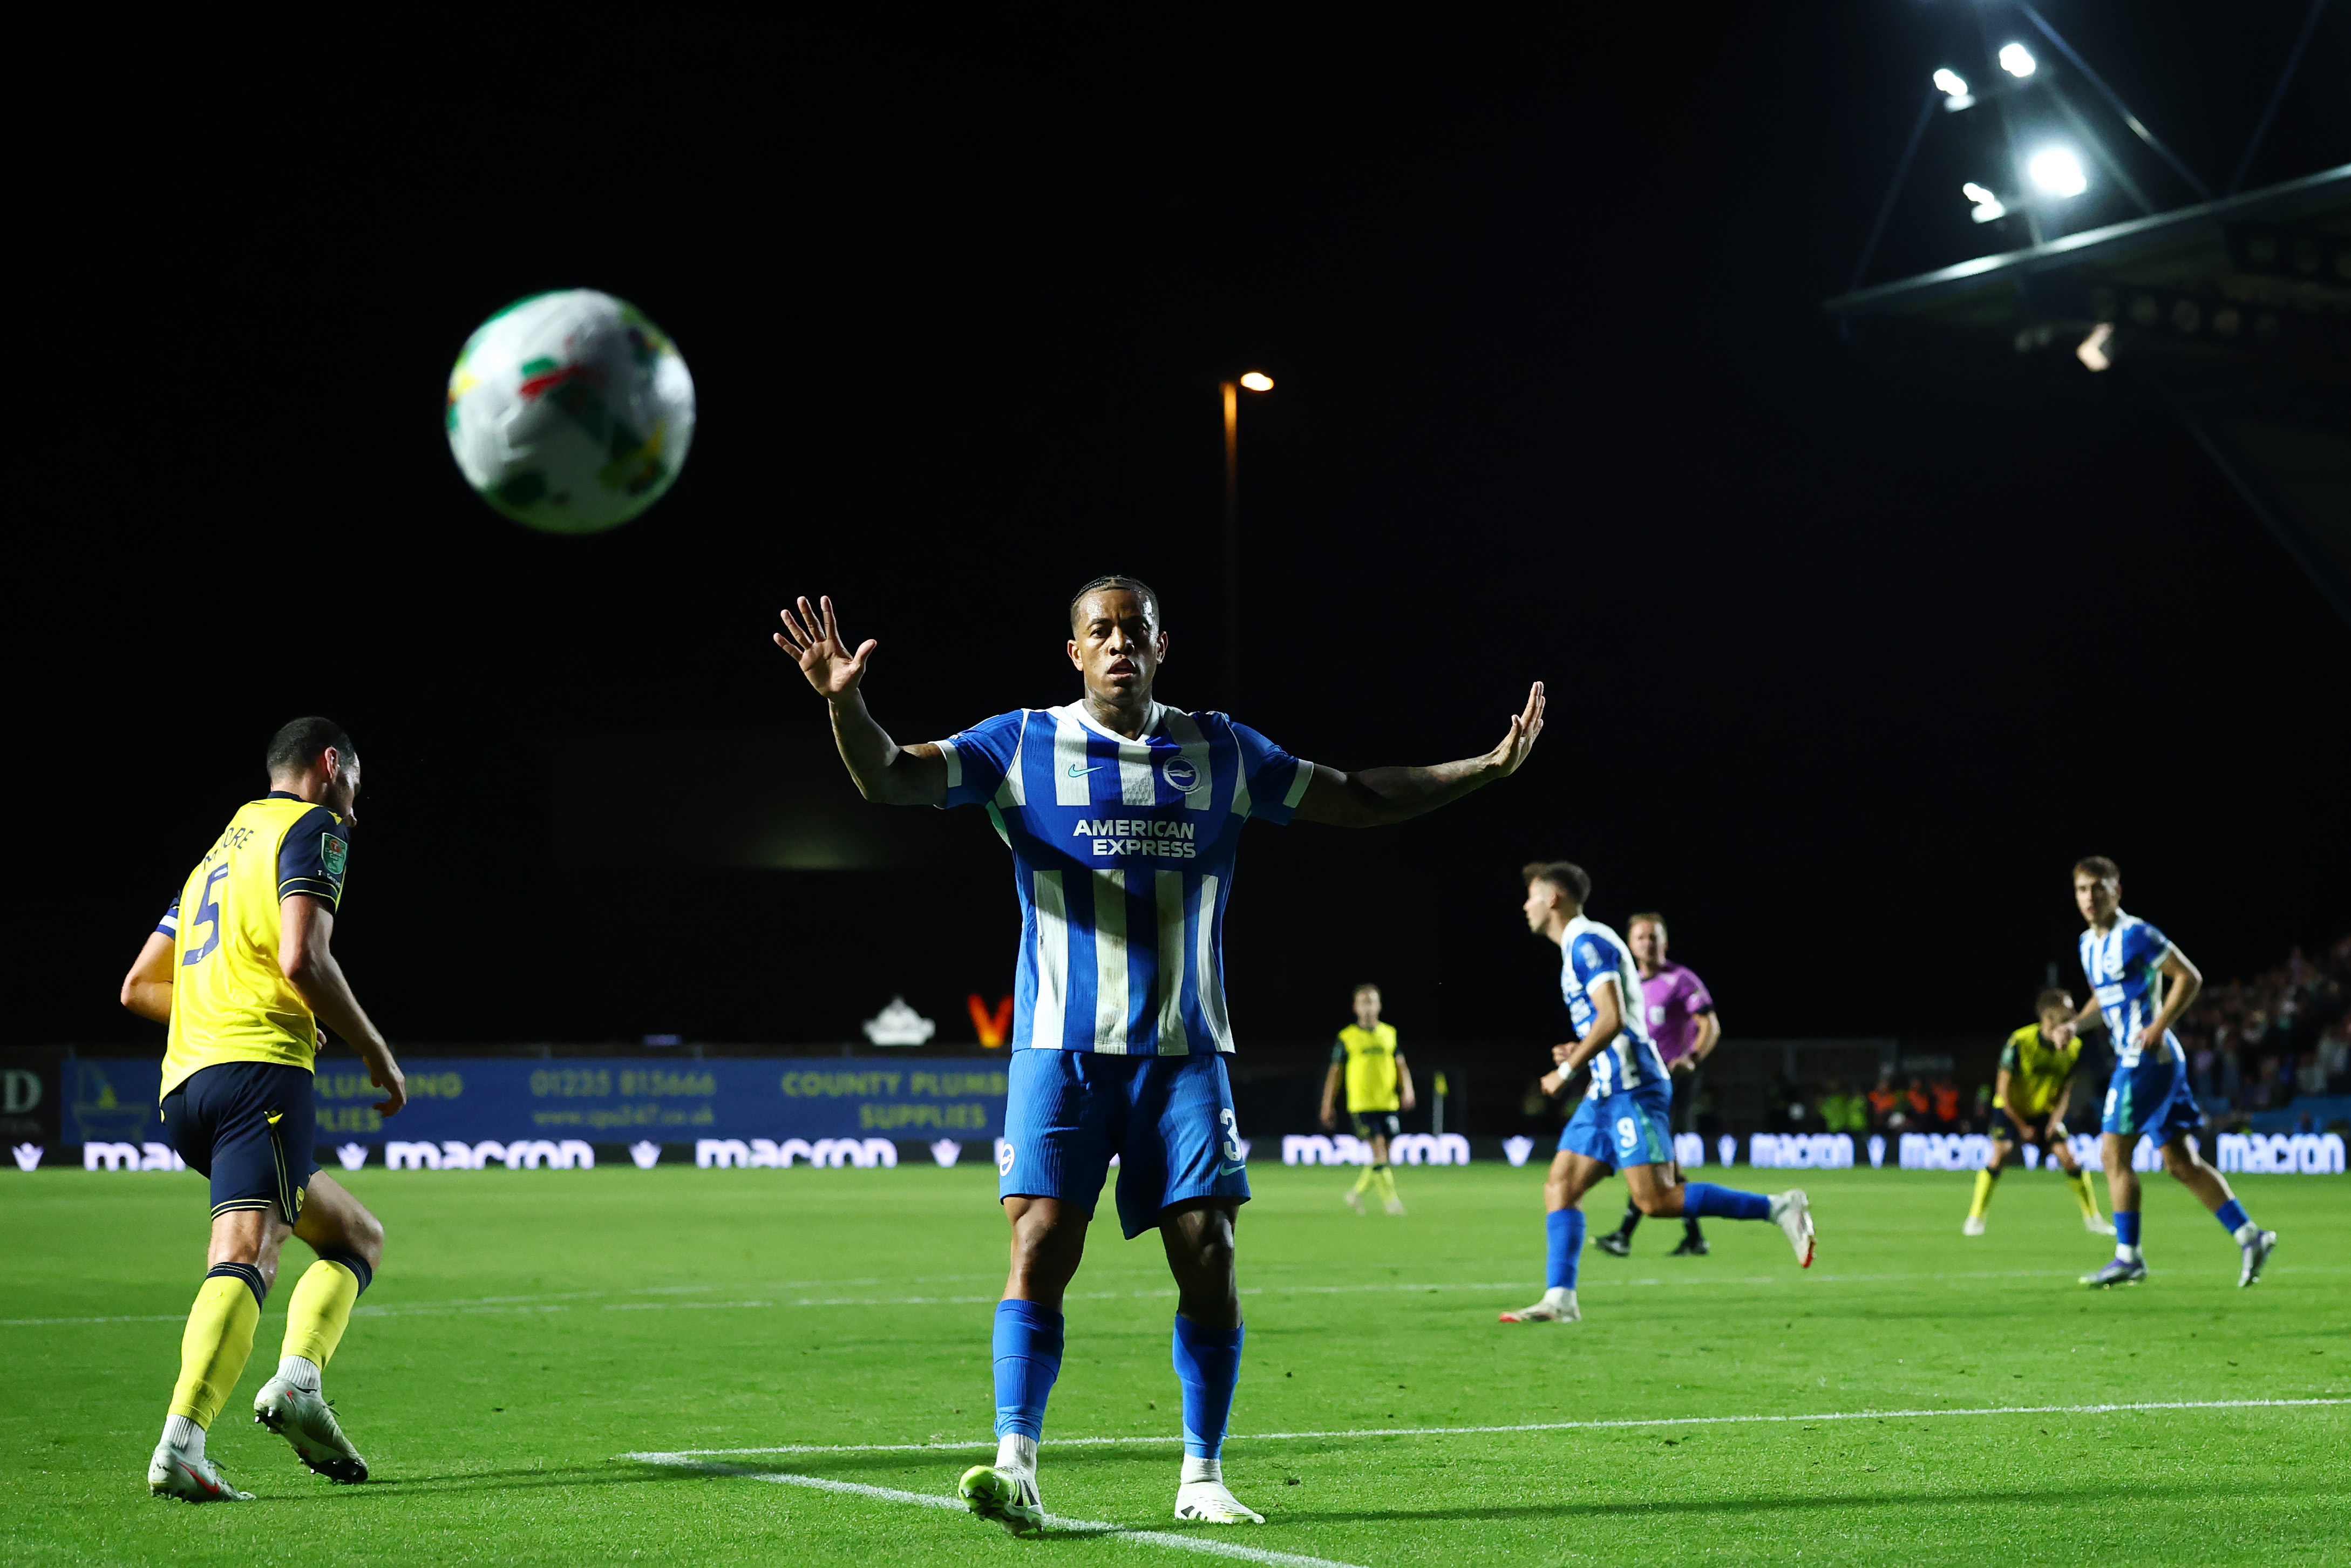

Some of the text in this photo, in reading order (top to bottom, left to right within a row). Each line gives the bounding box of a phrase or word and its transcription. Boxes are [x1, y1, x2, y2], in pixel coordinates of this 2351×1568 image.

[1073, 819, 1194, 839] AMERICAN
[203, 827, 254, 870] MORE
[1093, 839, 1196, 858] EXPRESS
[181, 862, 228, 967] 5
[781, 1070, 901, 1097] COUNTY
[859, 1104, 987, 1129] SUPPLIES
[1220, 1108, 1242, 1162] 3
[1617, 1117, 1637, 1148] 9
[385, 1140, 594, 1170] macron
[696, 1138, 898, 1169] macron
[2217, 1133, 2346, 1174] macron
